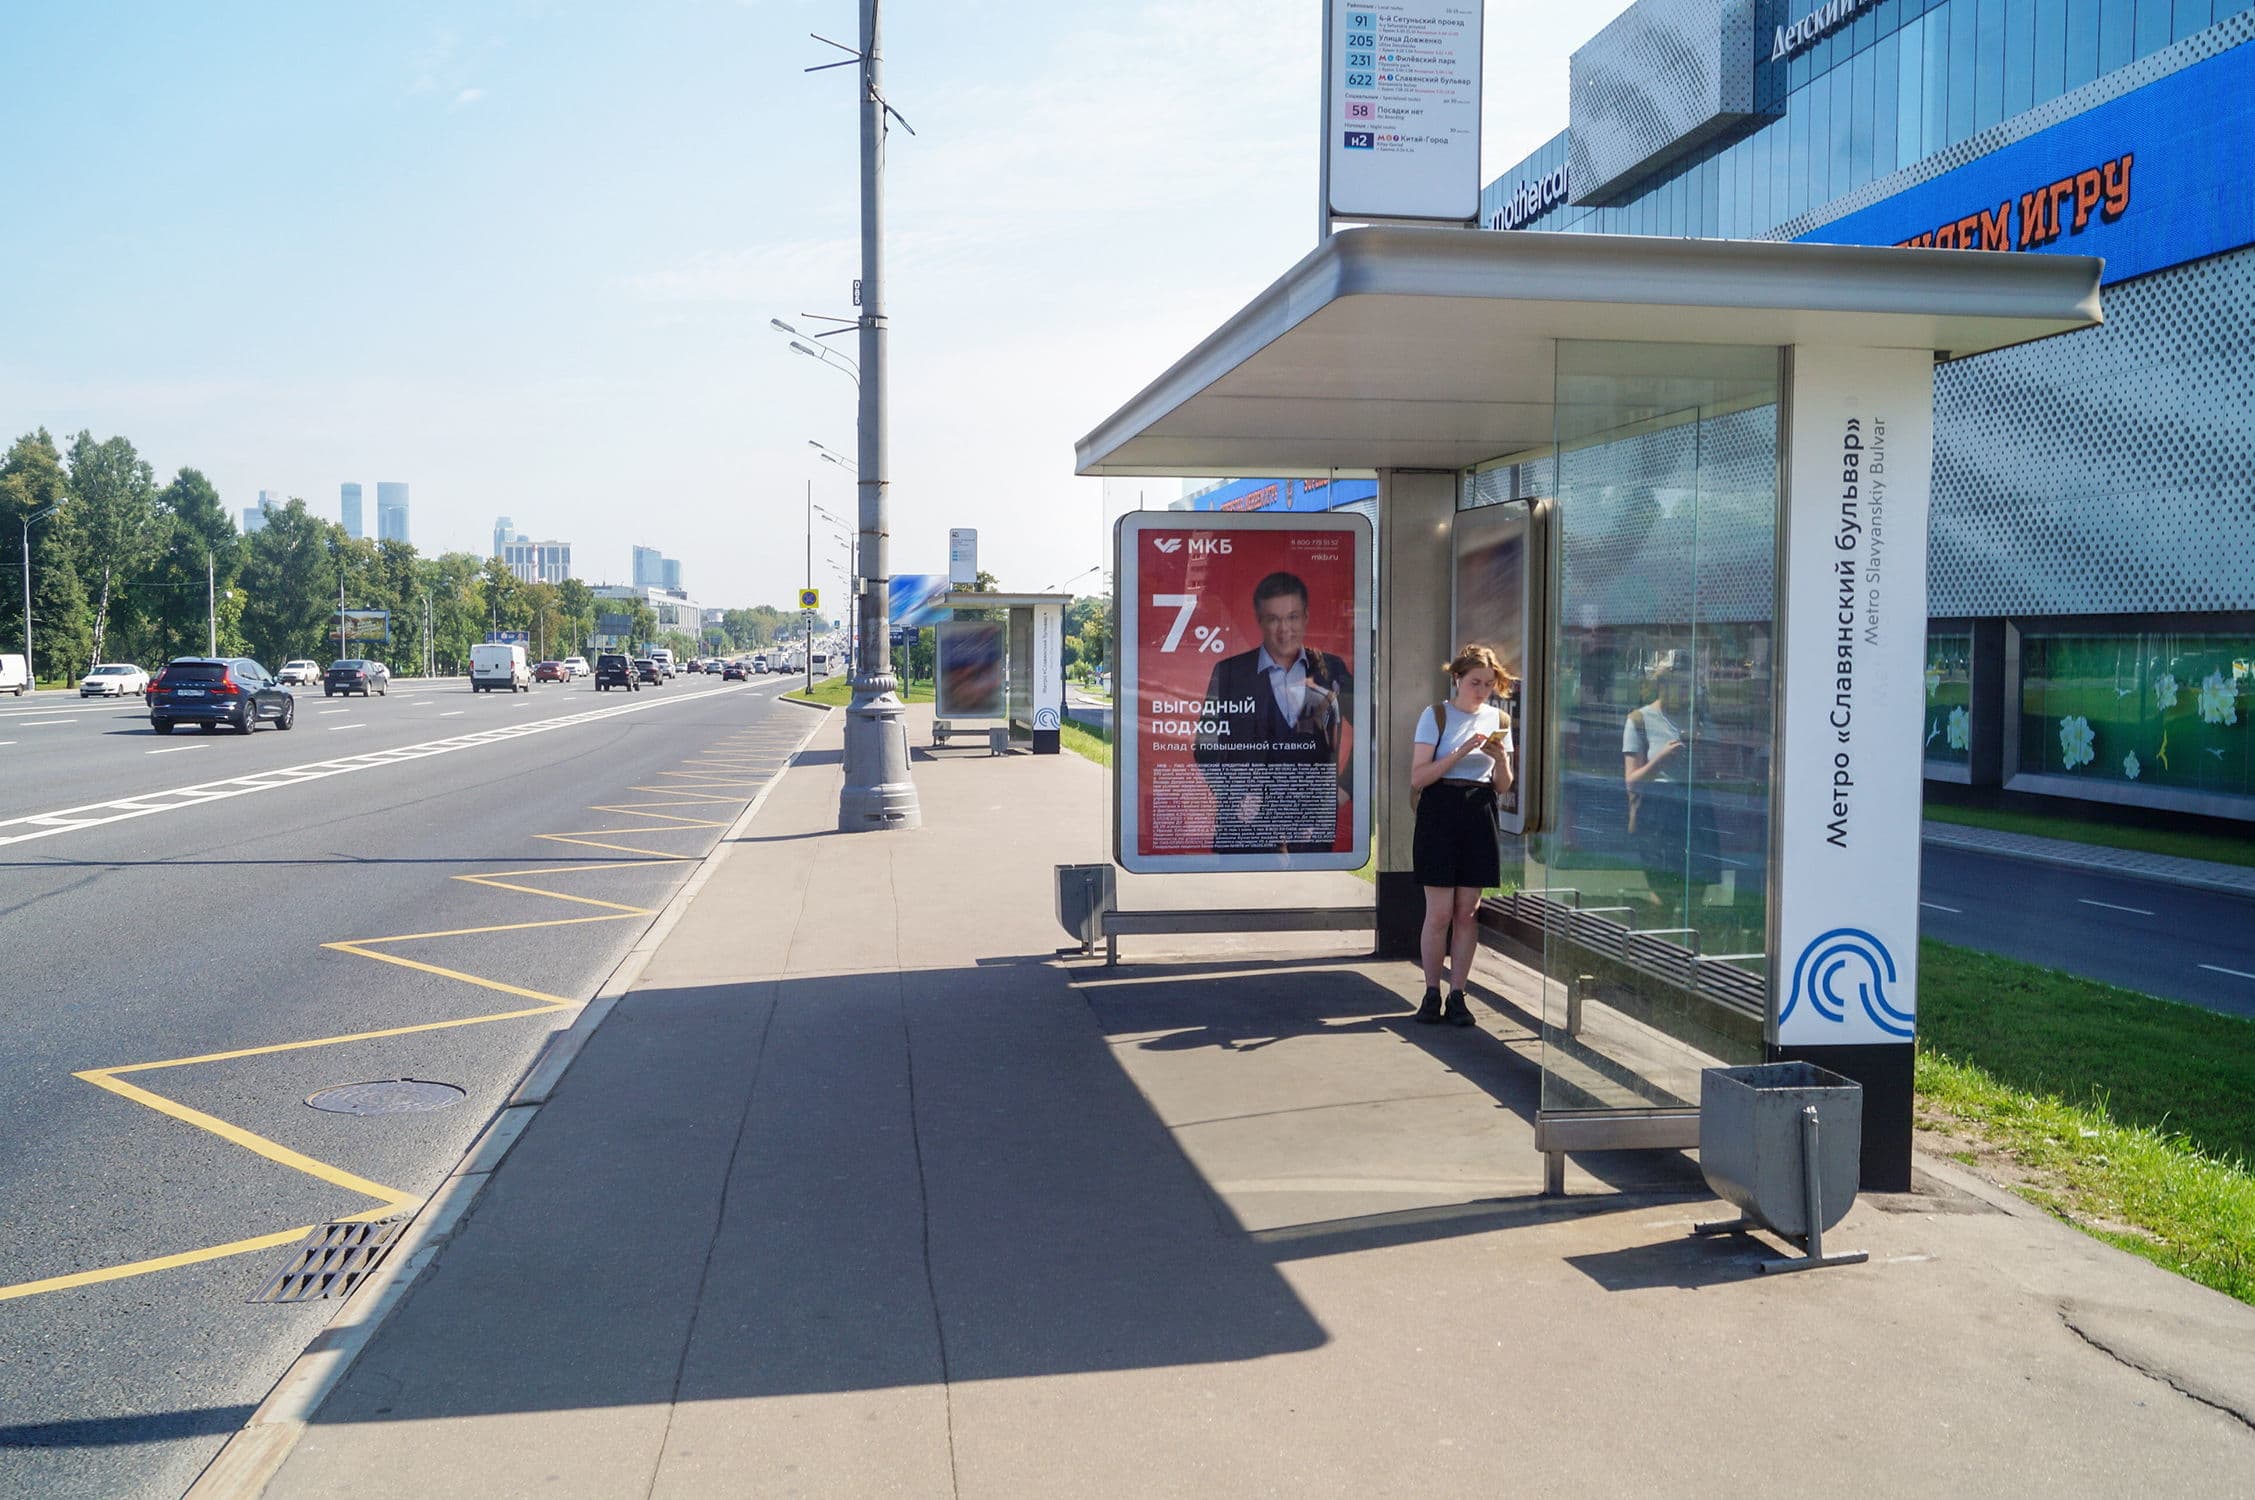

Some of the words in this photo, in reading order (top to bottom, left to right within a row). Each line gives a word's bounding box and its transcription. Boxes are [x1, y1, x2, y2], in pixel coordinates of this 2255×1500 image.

[1355, 15, 1367, 27] 91
[1393, 15, 1437, 24] Сетуньский
[1438, 18, 1465, 27] проезд
[1349, 35, 1373, 47] 205
[1379, 34, 1401, 43] Улица
[1403, 36, 1442, 44] Довженко
[1351, 54, 1370, 66] 231
[1348, 74, 1372, 86] 622
[1395, 74, 1439, 83] Славянский
[1440, 77, 1471, 86] бульвар
[1352, 105, 1368, 116] 58
[1378, 106, 1409, 115] Посадки
[1400, 135, 1448, 144] Китай-Город
[2021, 154, 2133, 246] ИГРУ
[1870, 417, 1886, 474] Bulvar
[1835, 418, 1864, 550] бульвар»
[1866, 479, 1887, 583] Slavyanskiy
[1188, 539, 1232, 554] МКБ
[1864, 589, 1879, 646] Metro
[1830, 560, 1856, 744] «Славянский
[1153, 742, 1187, 751] Вклад
[1200, 741, 1269, 751] повышенной
[1272, 741, 1316, 750] ставкой
[1827, 752, 1853, 848] Метро
